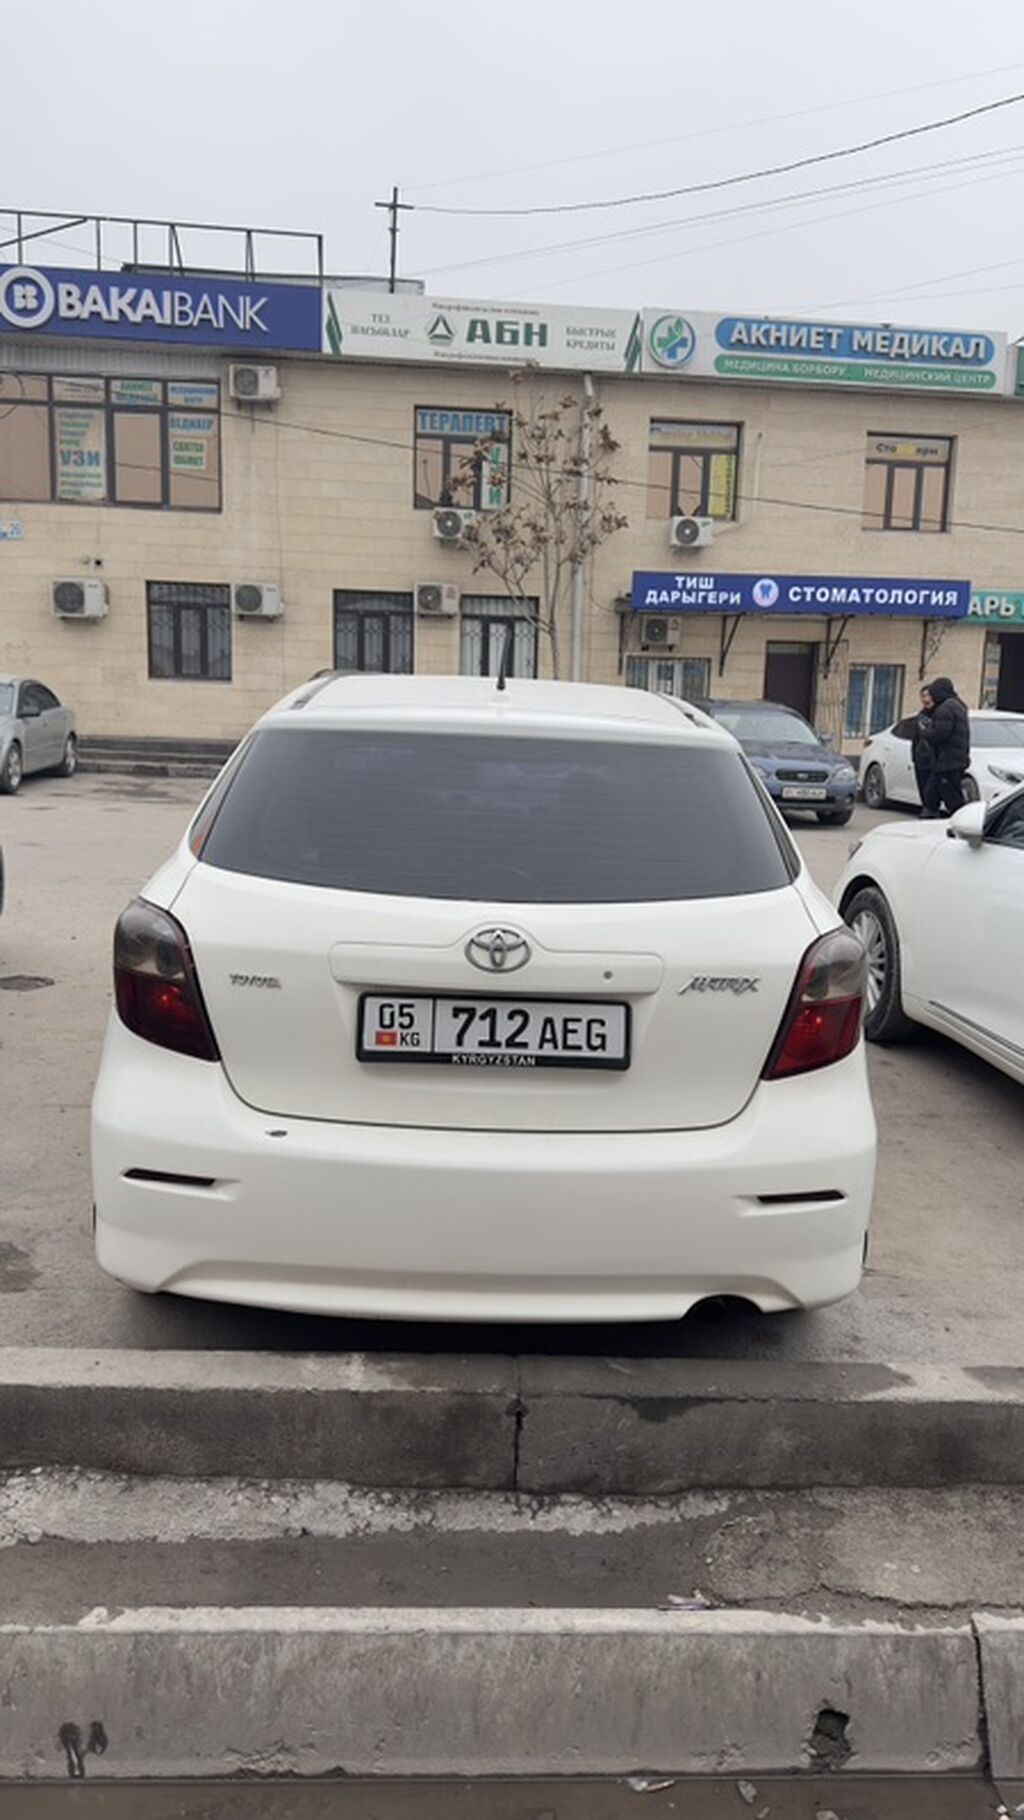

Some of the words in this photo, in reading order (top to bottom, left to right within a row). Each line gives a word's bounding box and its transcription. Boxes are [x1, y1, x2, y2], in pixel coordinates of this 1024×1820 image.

[466, 318, 548, 347] АБН
[729, 321, 843, 350] АКНИЕТ
[852, 329, 986, 361] МЕДИКАЛ
[566, 340, 616, 351] КРЕДИТЫ
[723, 359, 790, 373] МЕДИЦИНА
[793, 364, 848, 377] БОРБОРУ
[864, 367, 950, 382] МЕДИЦИНСКИЙ
[953, 373, 991, 383] ЦЕНТР
[60, 449, 101, 467] УЗИ
[675, 575, 714, 589] ТИШ
[645, 590, 741, 605] ДАРЫГЕРИ
[788, 586, 958, 606] СТОМАТОЛОГИЯ
[378, 1003, 415, 1029] 05
[400, 1032, 421, 1047] KG
[451, 1054, 536, 1067] KYRGYZSTAN
